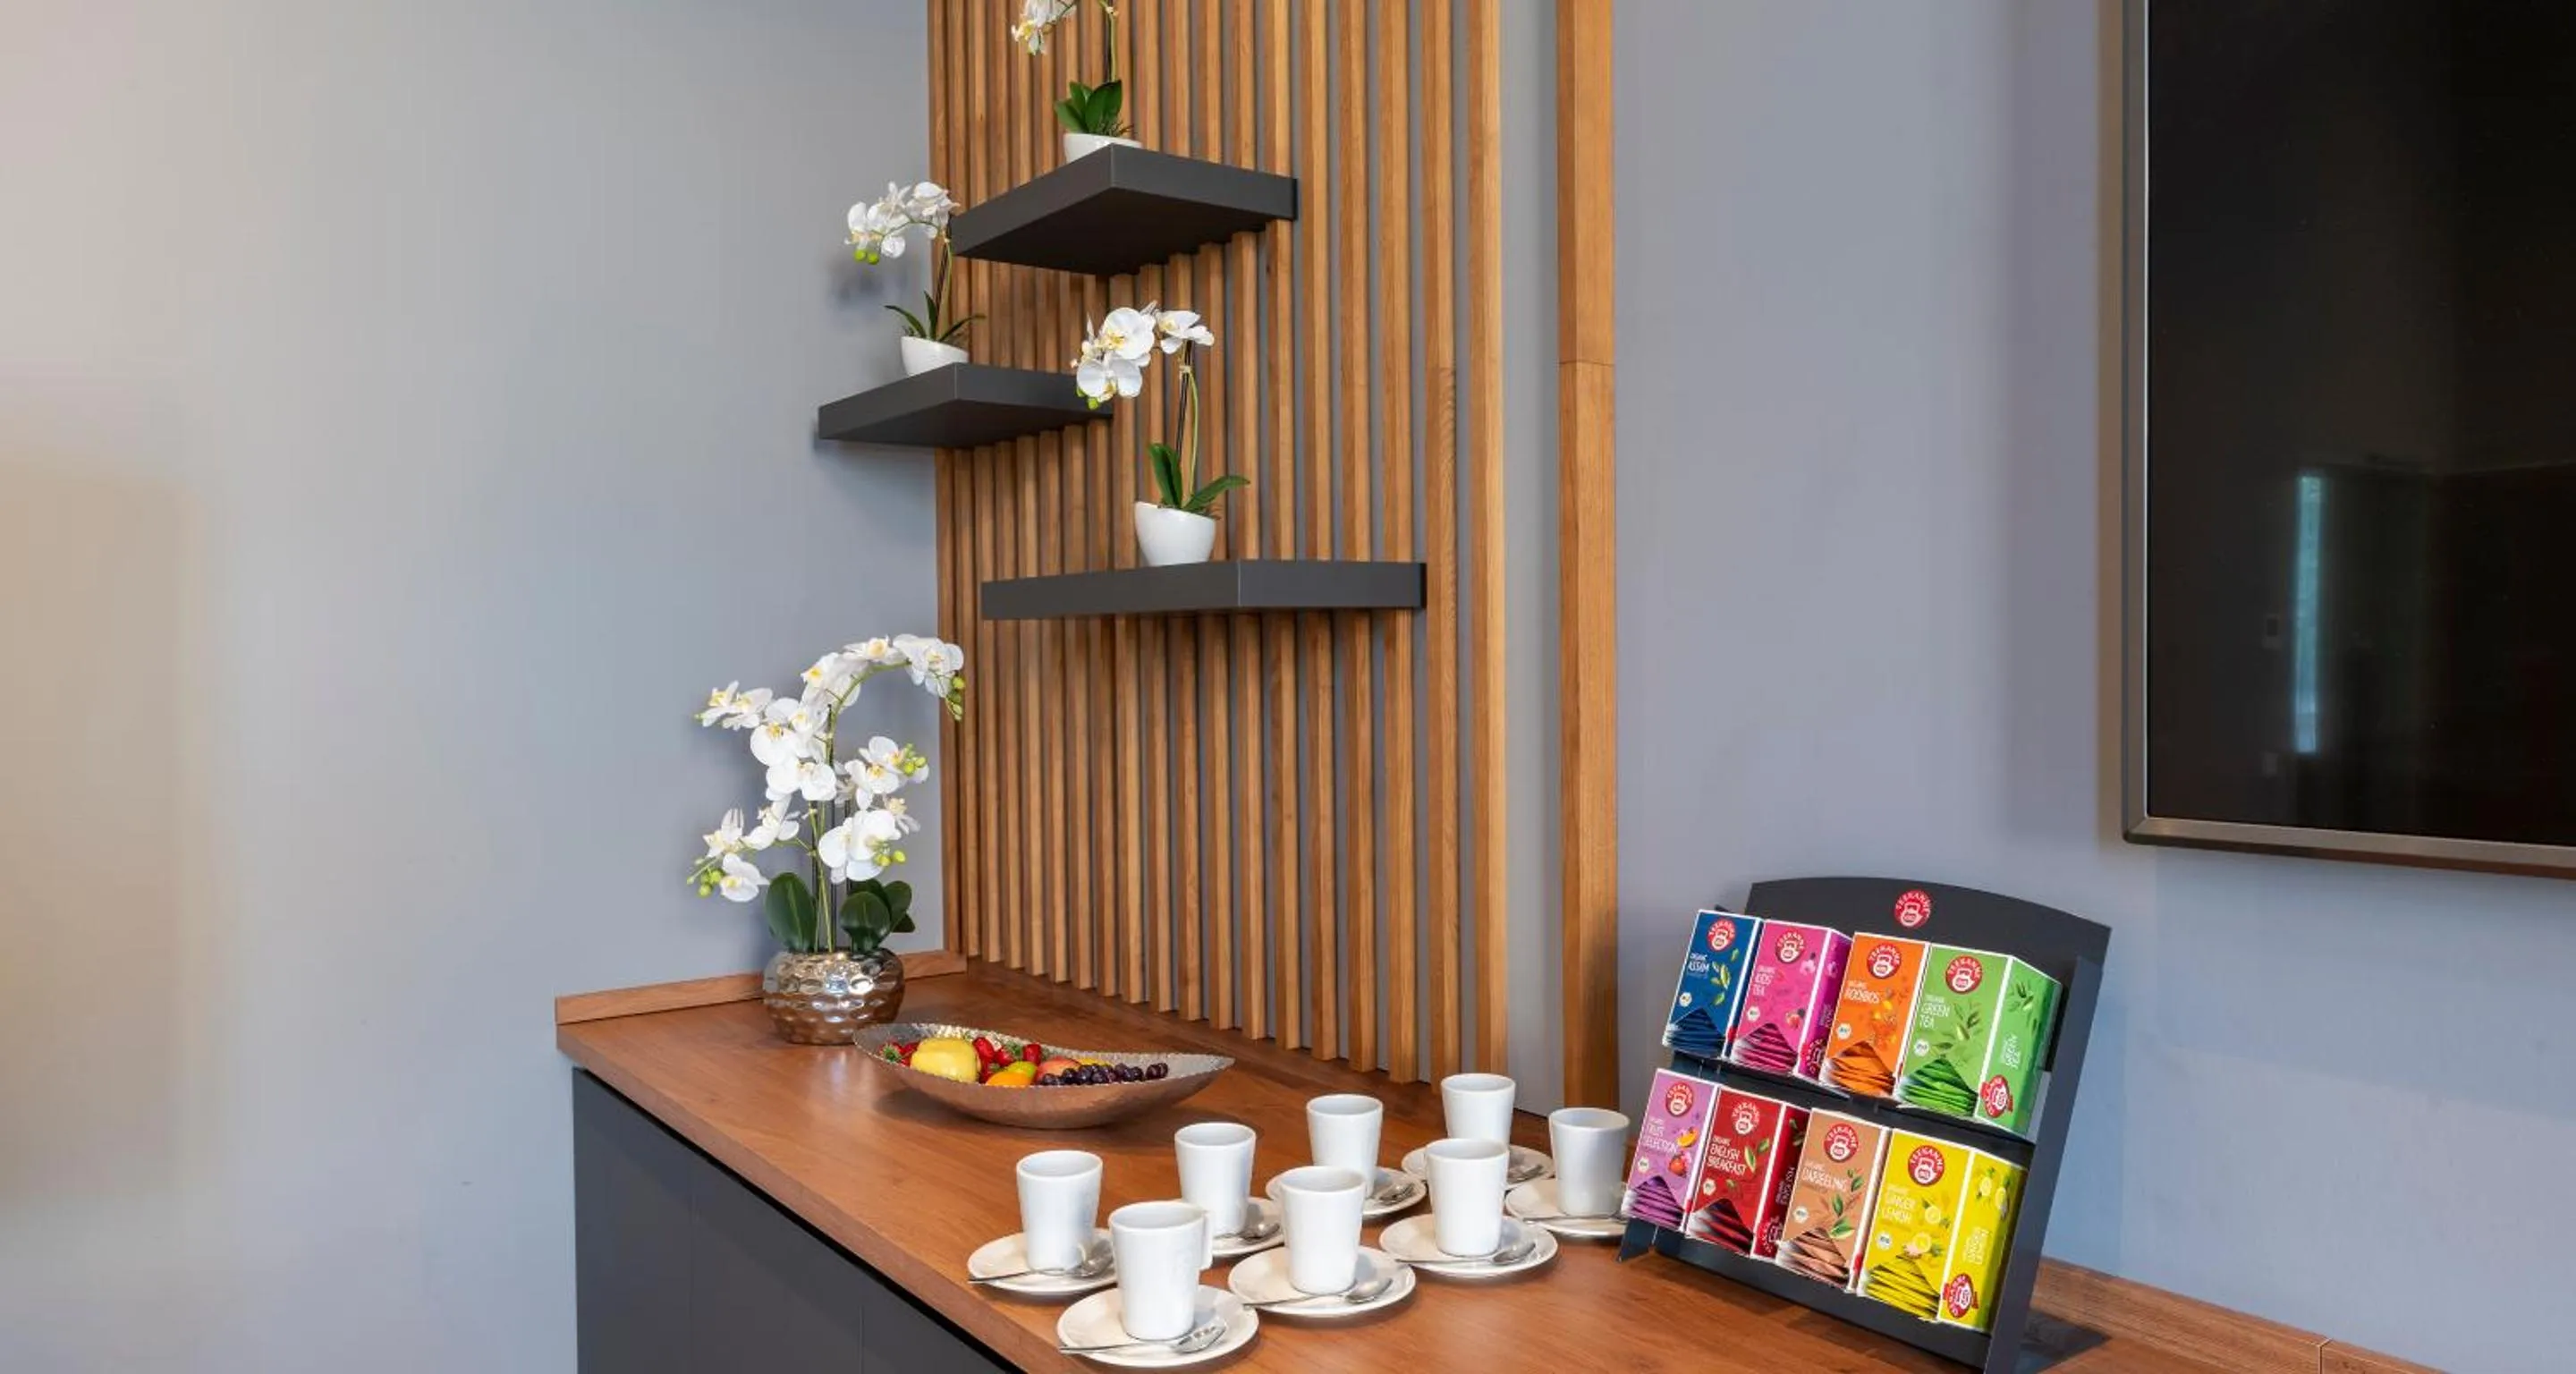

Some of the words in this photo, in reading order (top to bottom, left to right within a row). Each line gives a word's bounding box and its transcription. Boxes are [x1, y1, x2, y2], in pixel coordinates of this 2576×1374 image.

[1921, 1002, 1950, 1017] GREEN
[1919, 1014, 1936, 1029] TEA
[1709, 1143, 1741, 1161] ENGLISH
[1707, 1155, 1746, 1176] BREAKFAST
